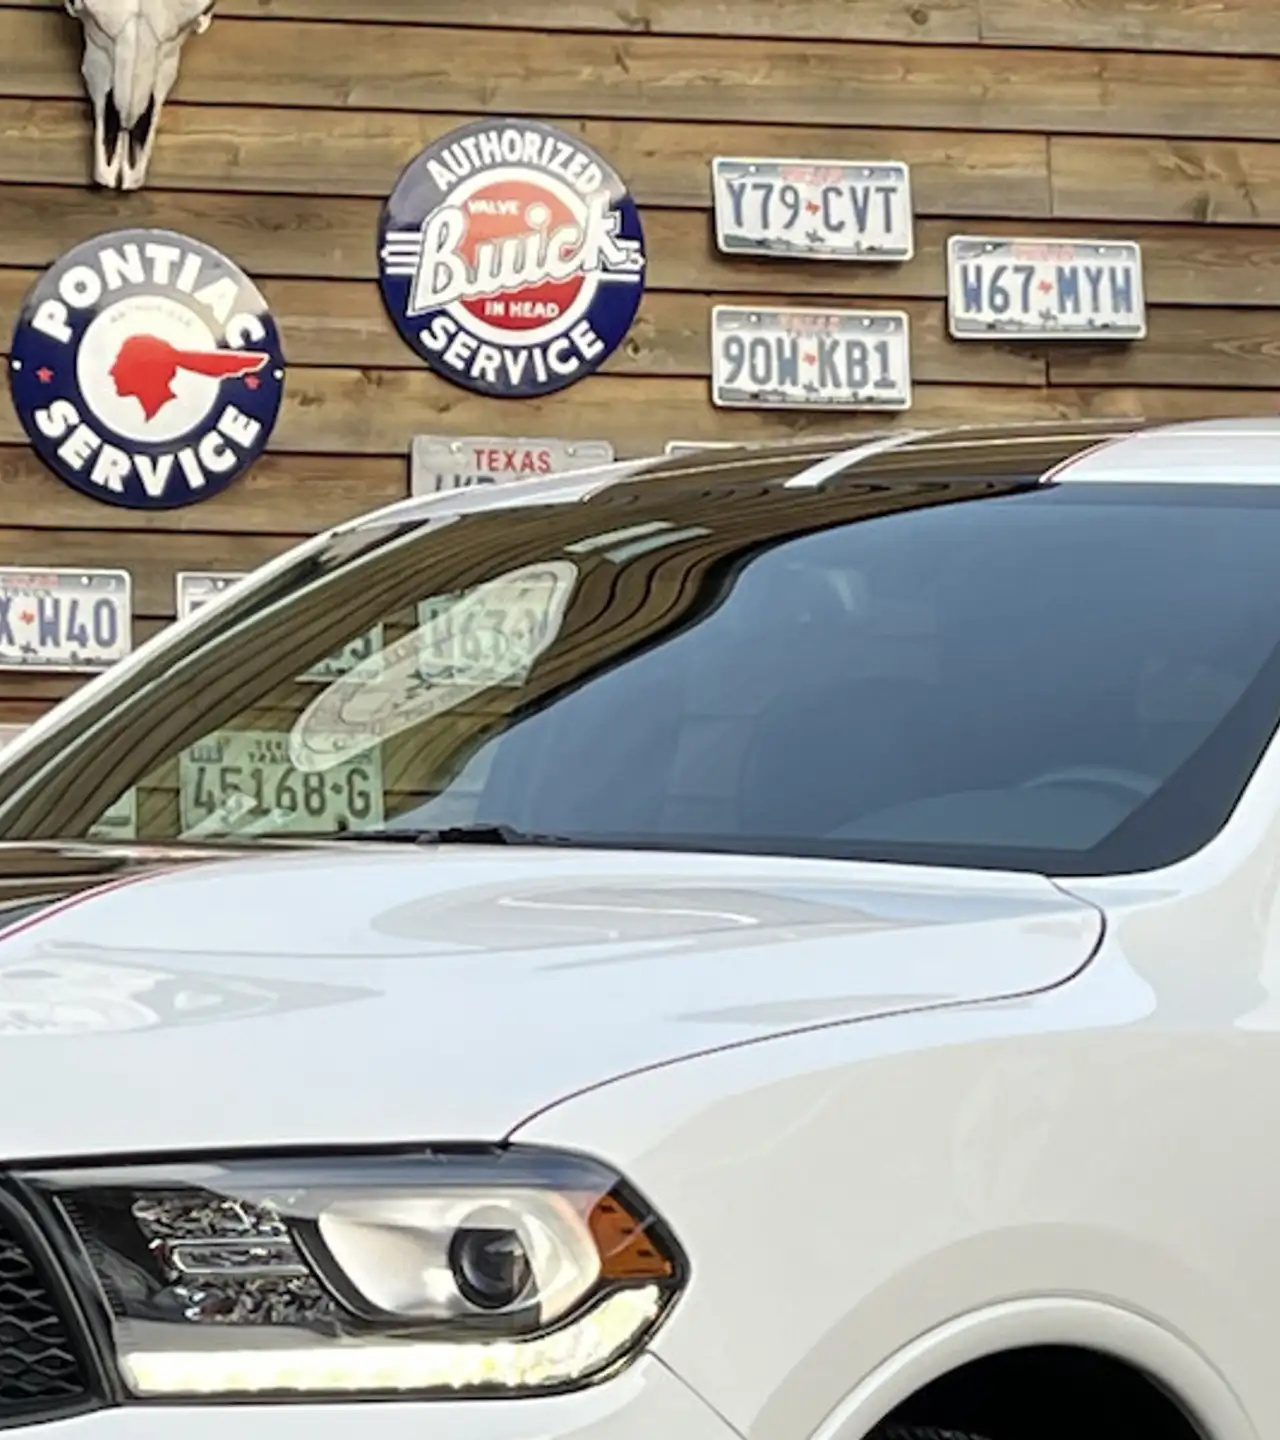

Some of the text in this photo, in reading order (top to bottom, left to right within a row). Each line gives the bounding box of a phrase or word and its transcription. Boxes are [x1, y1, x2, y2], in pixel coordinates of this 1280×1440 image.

[426, 129, 603, 195] AUTHORIZED
[468, 199, 521, 217] VALVE
[726, 182, 897, 234] Y79 CVT
[406, 190, 626, 316] Buick
[31, 243, 266, 349] PONTIAC
[484, 301, 560, 318] IN HEAD
[420, 316, 605, 386] SERVICE
[820, 339, 896, 389] KB1
[34, 399, 262, 496] SERVICE
[473, 448, 552, 474] TEXAS
